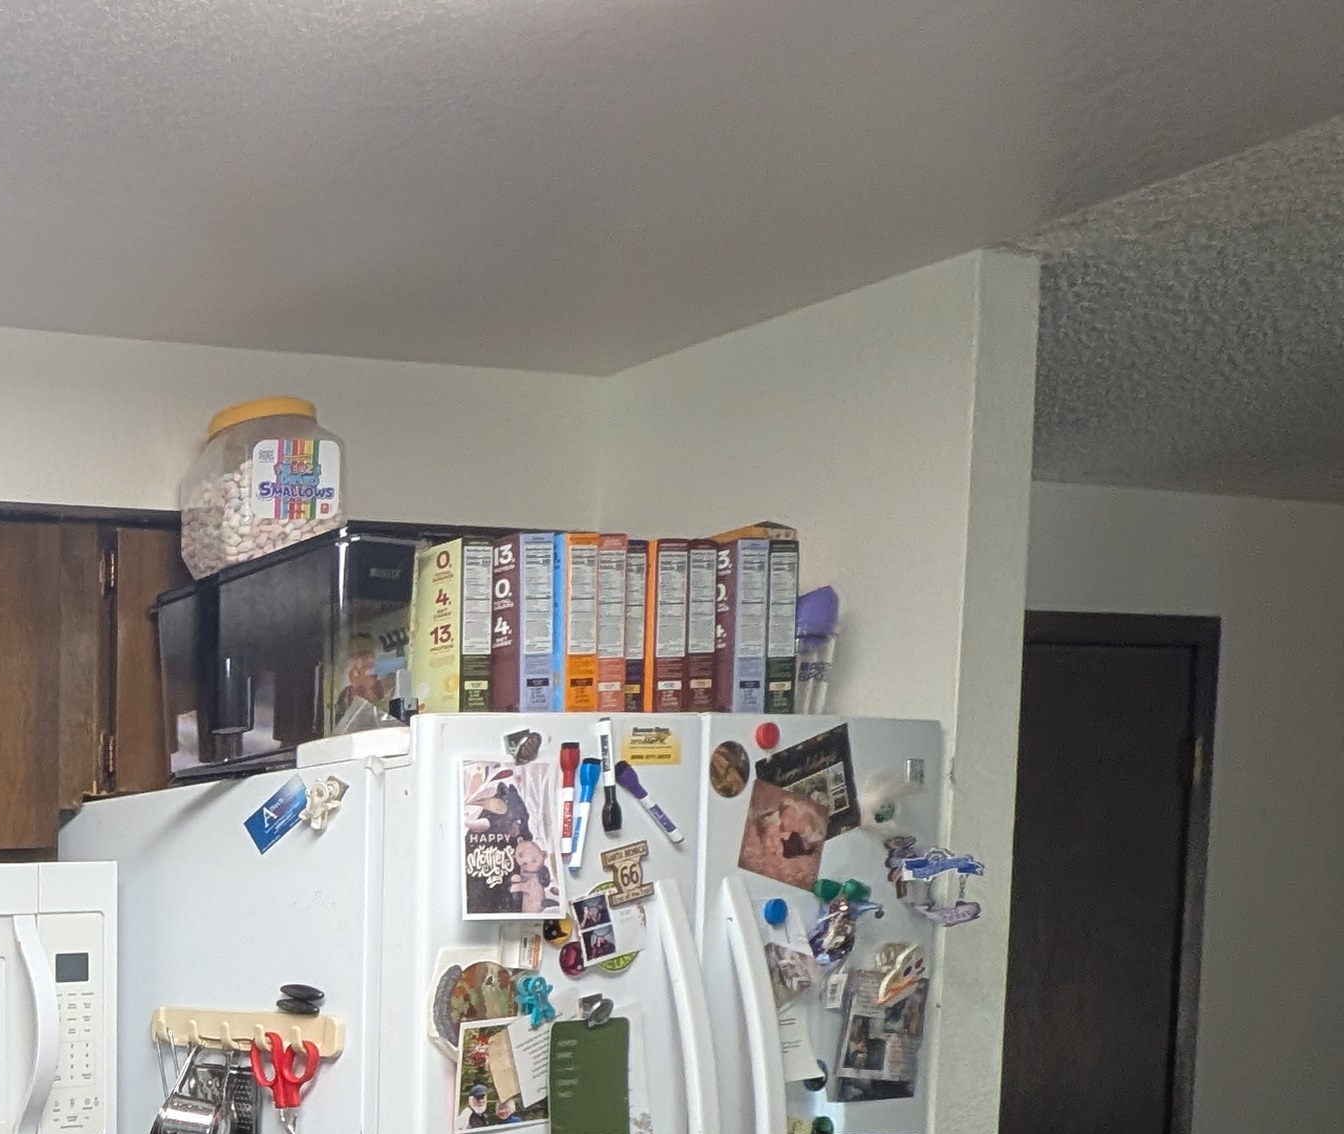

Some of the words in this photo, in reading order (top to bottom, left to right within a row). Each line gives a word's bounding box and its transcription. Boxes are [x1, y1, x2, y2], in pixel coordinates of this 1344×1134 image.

[258, 482, 334, 499] SMALLOWS
[470, 833, 510, 843] HAPPY
[620, 864, 639, 887] 66
